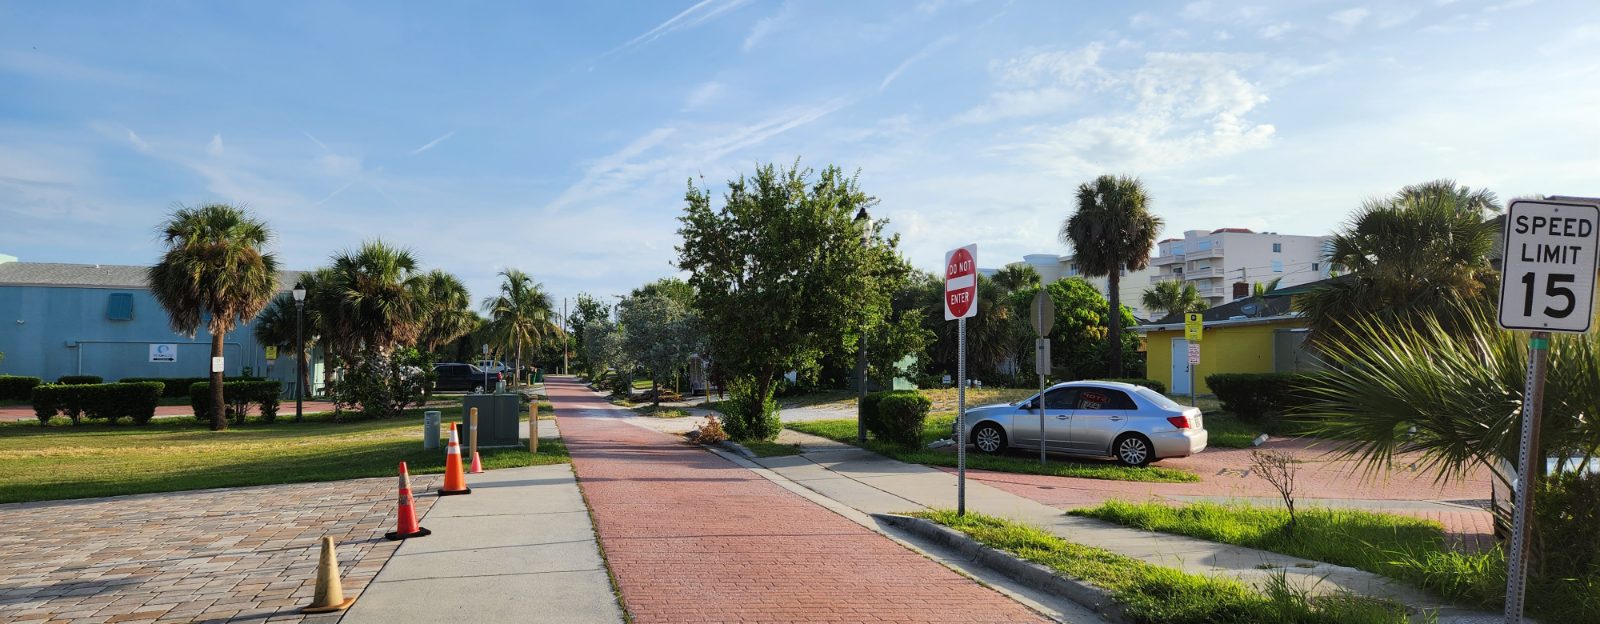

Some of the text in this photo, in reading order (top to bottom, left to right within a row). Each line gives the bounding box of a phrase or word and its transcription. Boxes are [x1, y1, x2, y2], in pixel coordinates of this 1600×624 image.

[1515, 215, 1592, 238] SPEED
[1521, 243, 1582, 265] LIMIT
[950, 260, 972, 275] DO NOT
[951, 292, 969, 305] ENTER
[1521, 272, 1576, 319] 15
